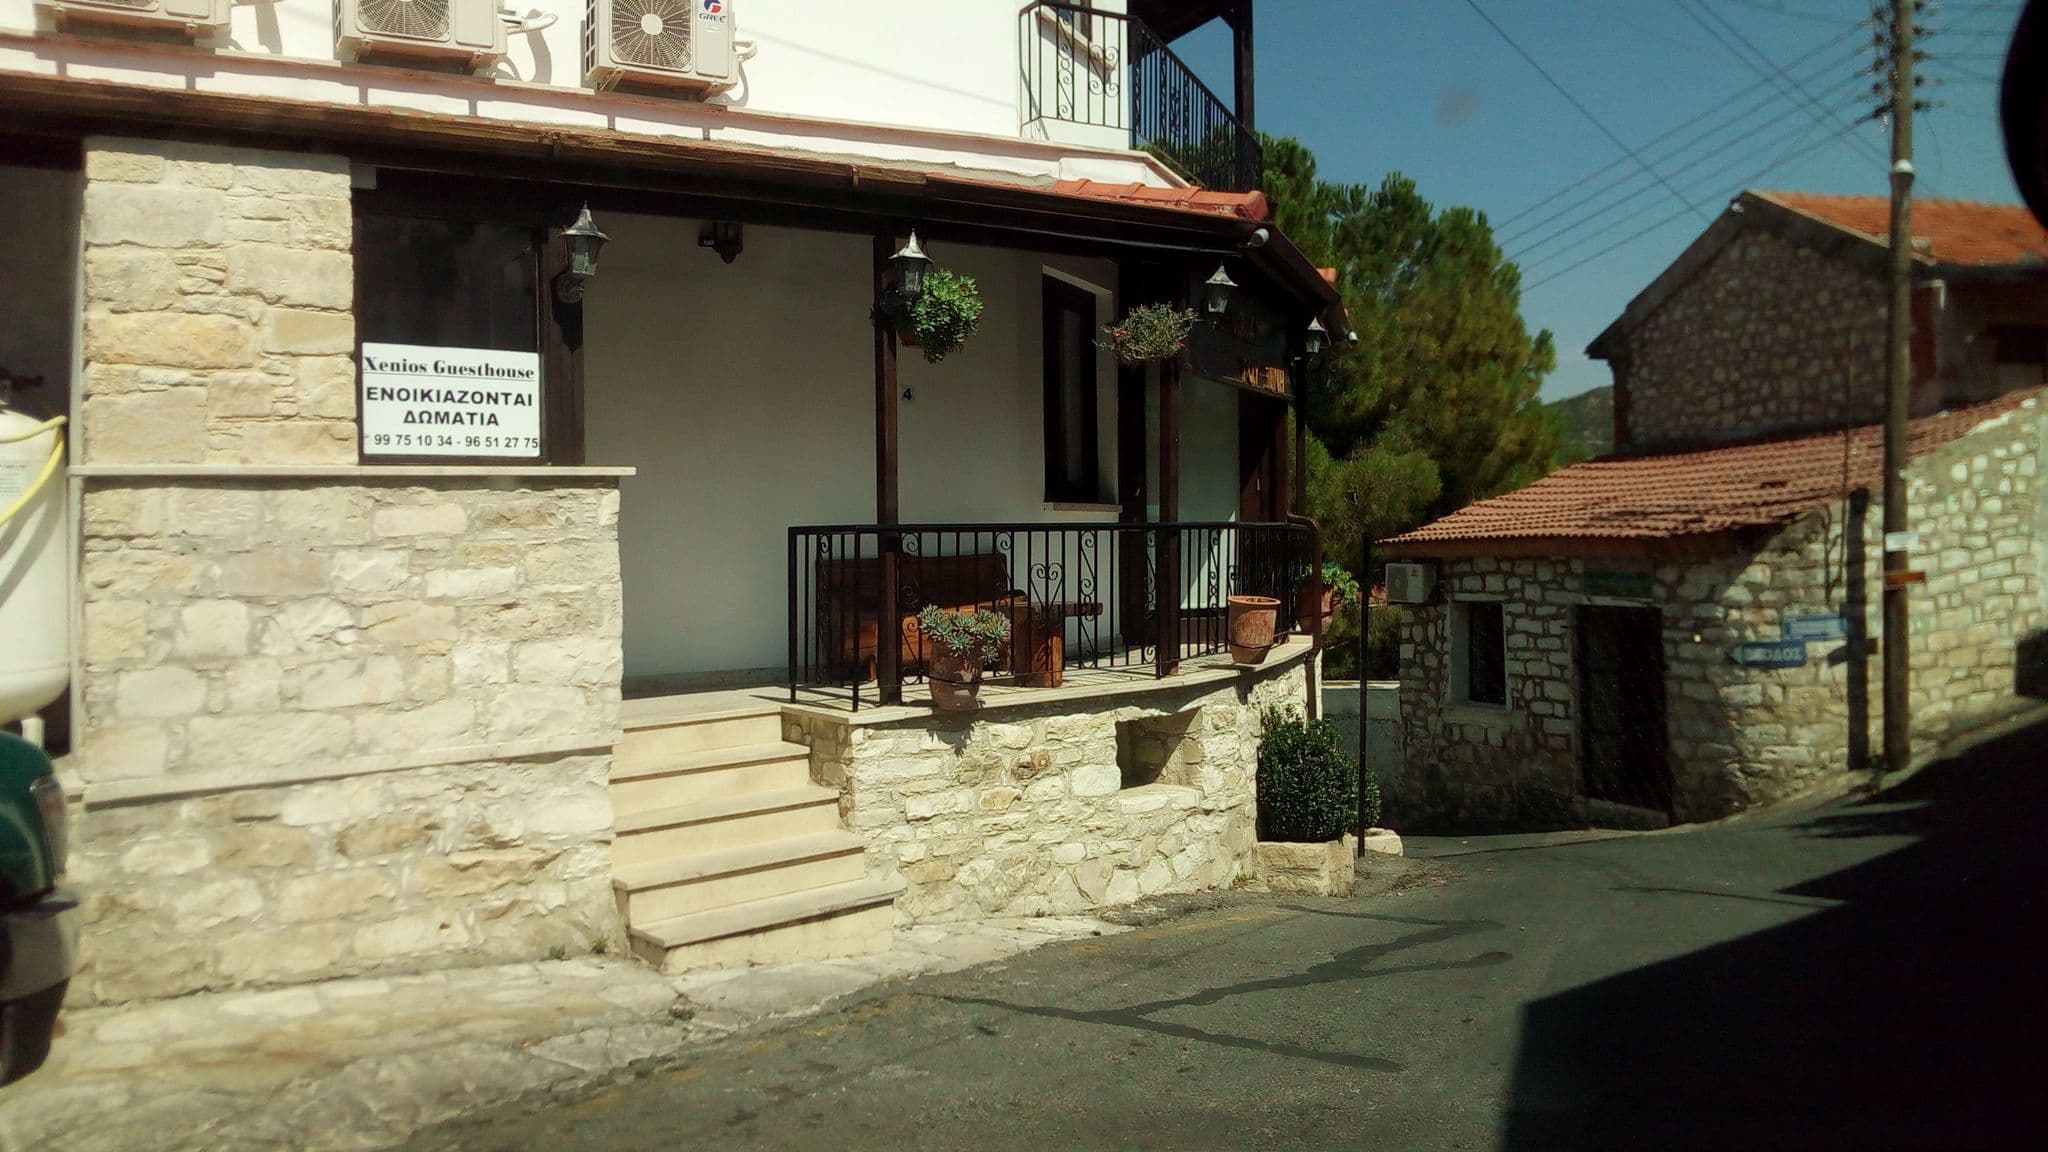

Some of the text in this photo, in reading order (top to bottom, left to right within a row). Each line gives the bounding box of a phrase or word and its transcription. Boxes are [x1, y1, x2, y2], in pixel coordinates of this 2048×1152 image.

[699, 12, 726, 23] GREE
[364, 356, 535, 380] Xenios Guesthouse
[366, 386, 532, 406] ΕΝΟΙΚΙΑΖΟΝΤΑΙ
[903, 388, 913, 400] 4
[403, 410, 499, 426] ΔΩΜΑΤΙΑ
[374, 434, 390, 446] 99
[395, 434, 412, 446] 75
[418, 435, 432, 446] 10
[437, 435, 453, 446] 34
[465, 436, 481, 447] 96
[485, 436, 499, 447] 51
[505, 437, 519, 448] 27
[524, 437, 539, 449] 75
